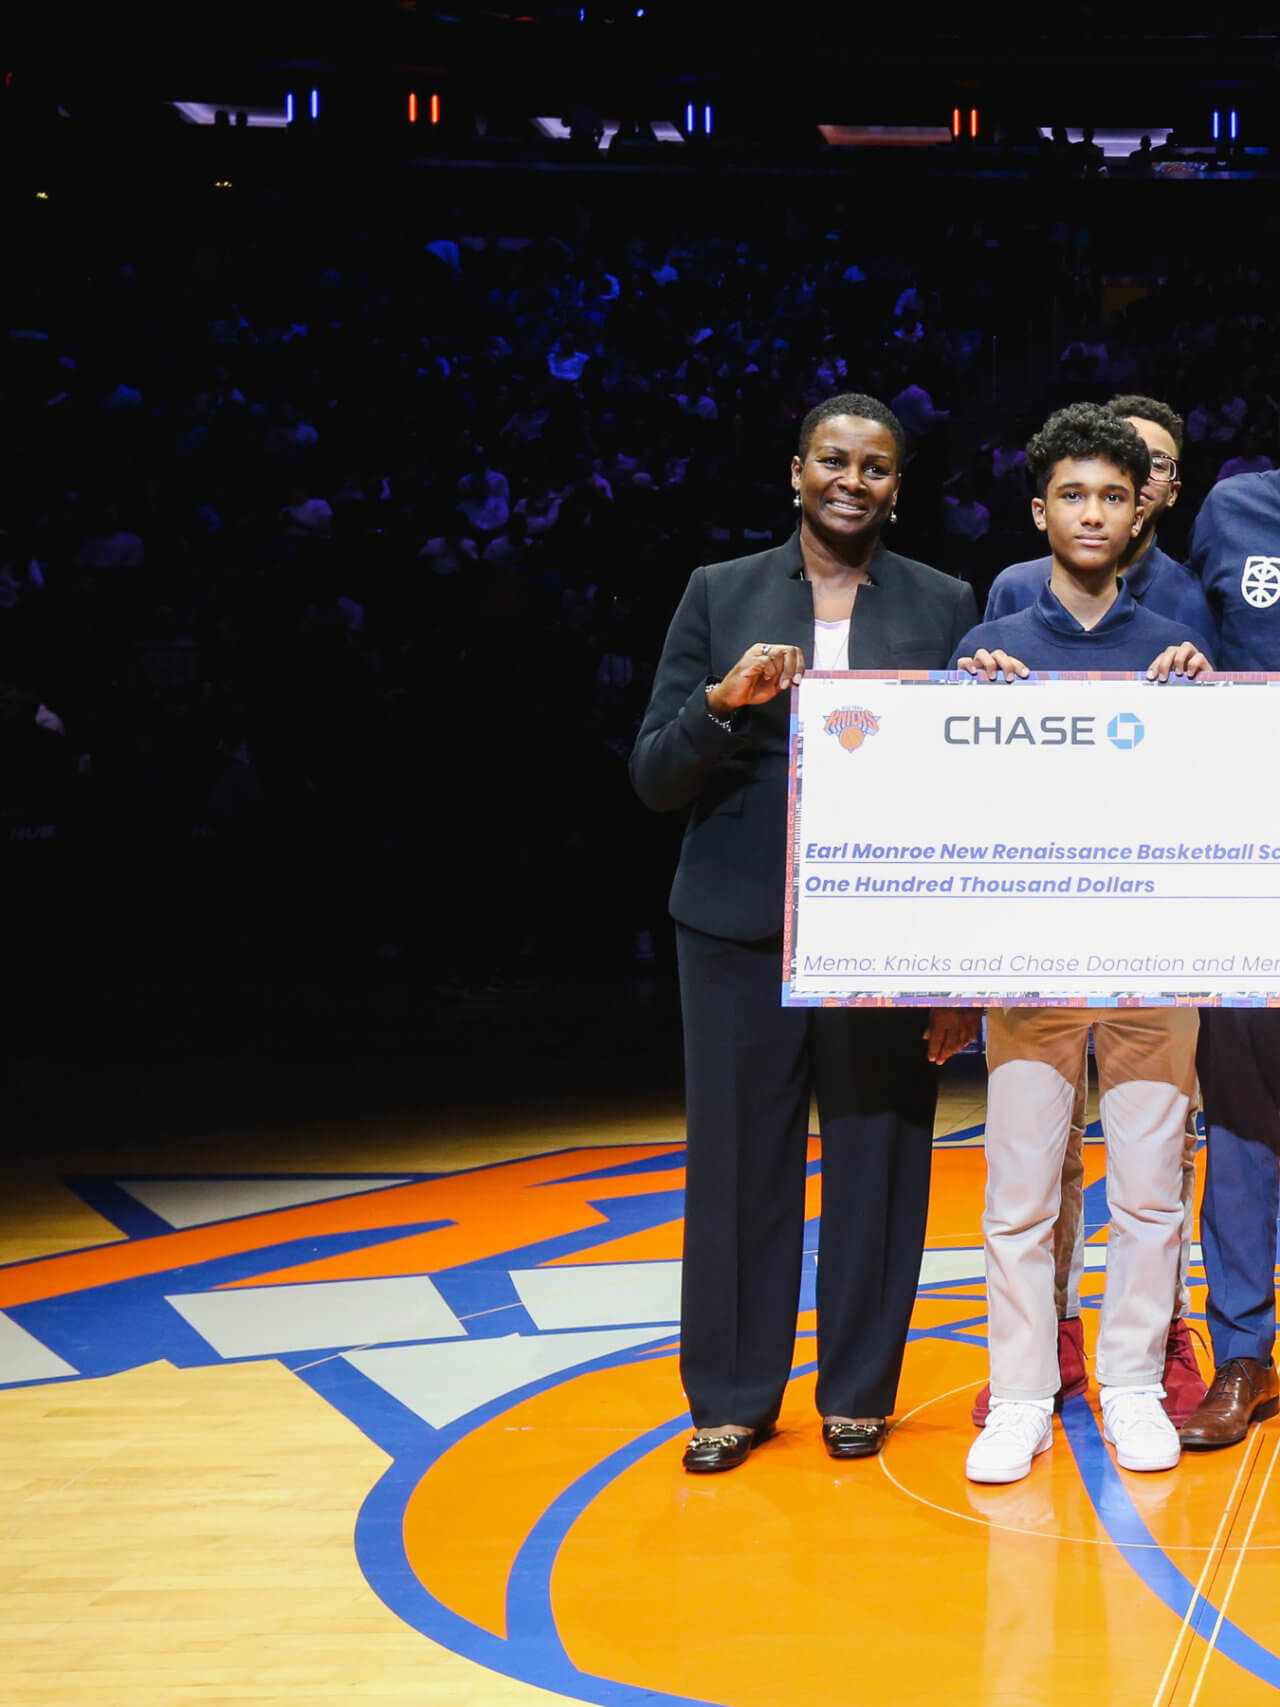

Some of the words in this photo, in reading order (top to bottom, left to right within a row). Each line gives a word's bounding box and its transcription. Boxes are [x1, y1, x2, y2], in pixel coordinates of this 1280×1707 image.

[944, 716, 1097, 745] CHASE
[805, 843, 849, 860] Earl
[851, 843, 936, 860] Monroe
[940, 843, 989, 860] New
[992, 842, 1133, 860] Renaissance
[1136, 843, 1254, 860] Basketball
[805, 876, 851, 893] One
[854, 875, 954, 893] Hundred
[960, 876, 1073, 893] Thousand
[1076, 876, 1156, 893] Dollars
[803, 954, 877, 972] Memo:
[884, 954, 951, 972] Knicks
[959, 954, 1003, 972] and
[1009, 954, 1080, 972] Chase
[1086, 954, 1185, 972] Donation
[1192, 954, 1236, 972] and
